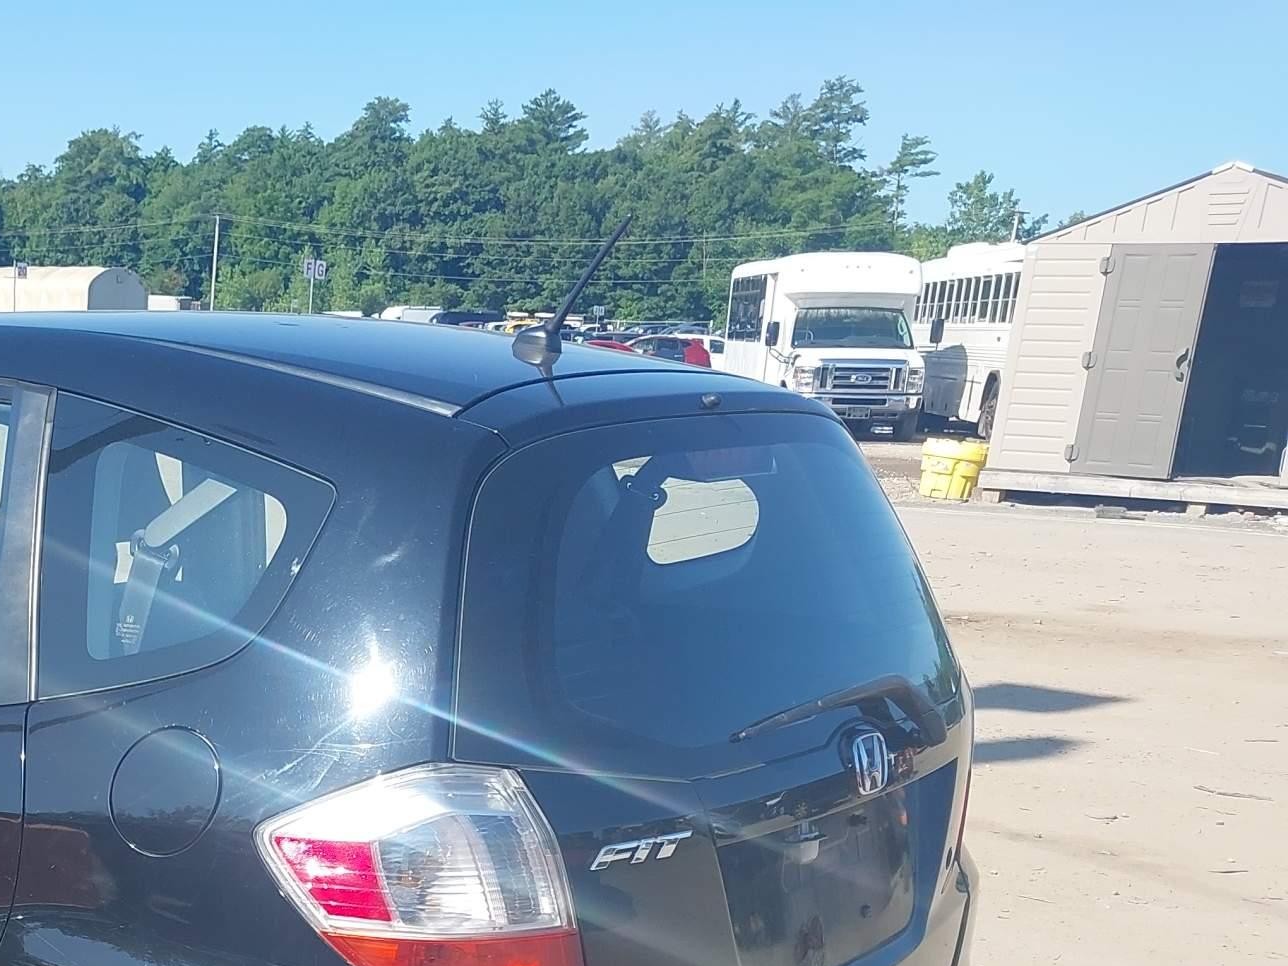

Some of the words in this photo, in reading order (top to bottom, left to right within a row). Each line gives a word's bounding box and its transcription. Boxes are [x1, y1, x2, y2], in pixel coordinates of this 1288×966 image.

[306, 262, 313, 276] F
[317, 263, 325, 277] G
[589, 830, 694, 871] FIT
